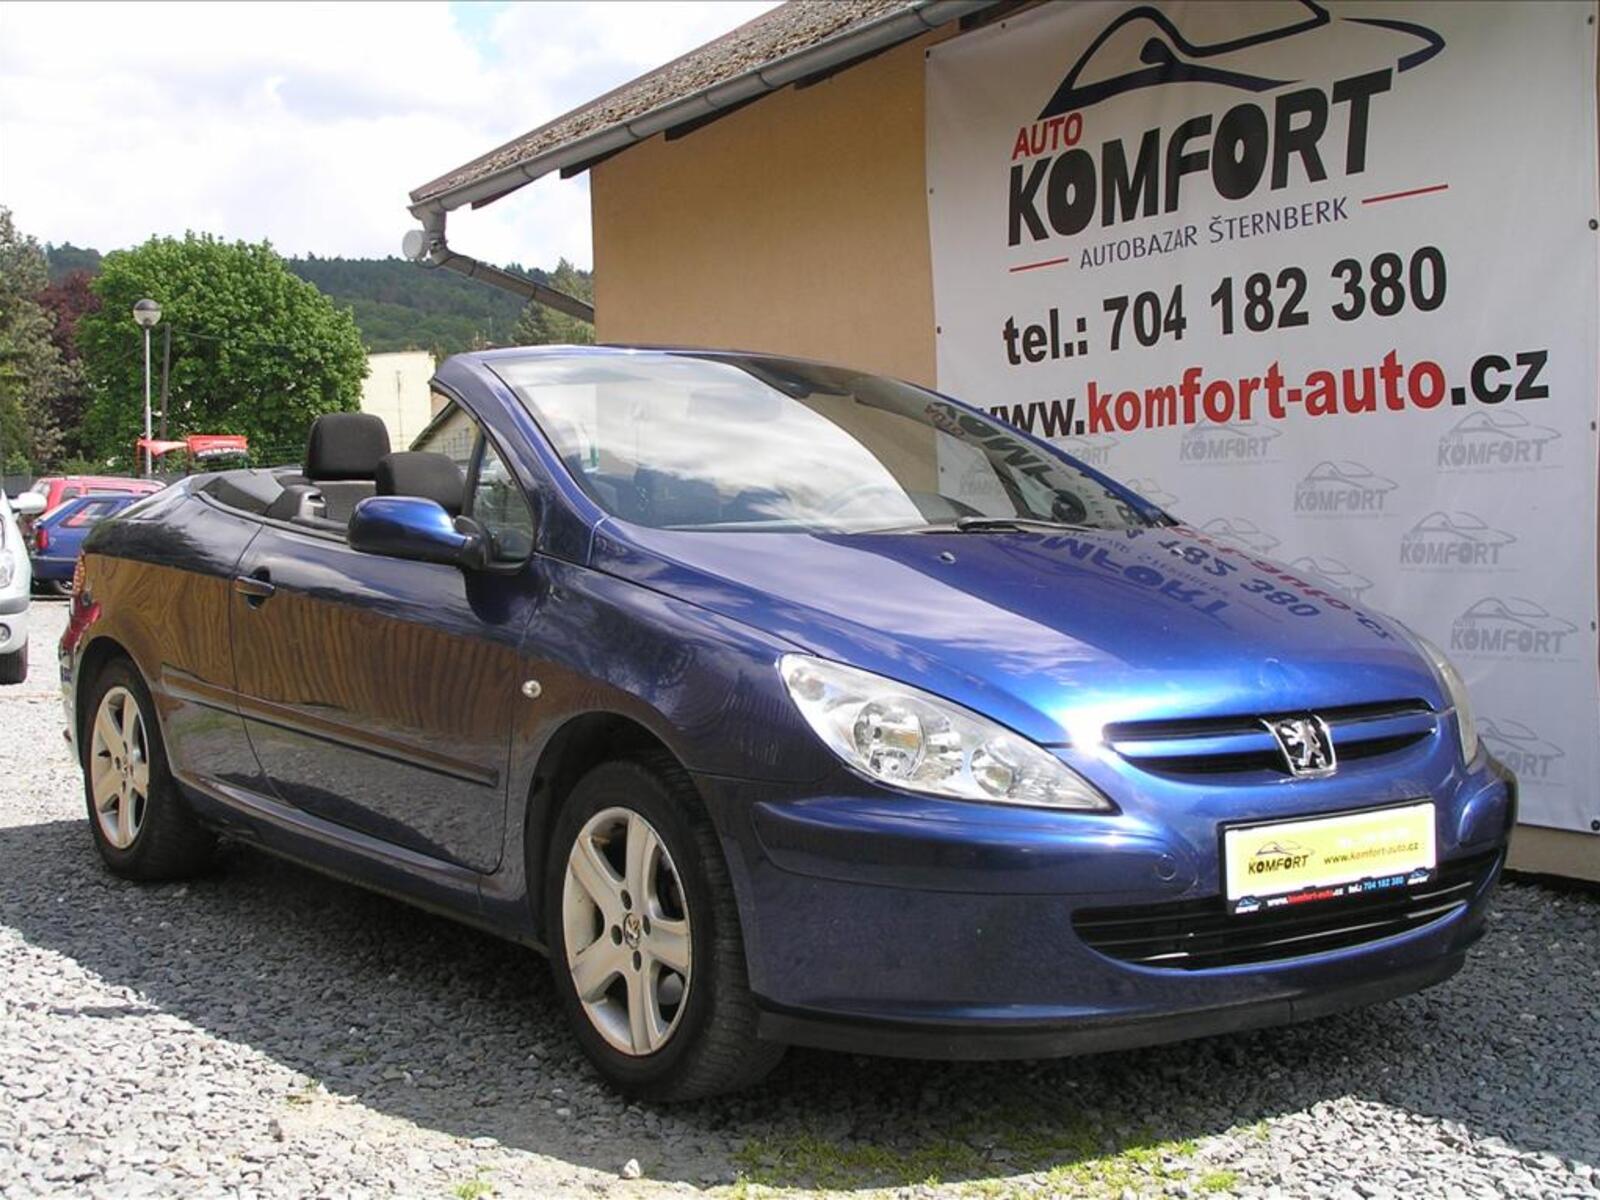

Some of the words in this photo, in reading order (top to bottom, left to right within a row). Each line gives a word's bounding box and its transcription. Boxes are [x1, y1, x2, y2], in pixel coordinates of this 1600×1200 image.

[1012, 112, 1082, 160] AUTO
[1008, 68, 1393, 247] KOMFORT
[1080, 225, 1197, 269] AUTOBAZAR
[1208, 196, 1348, 243] ŠTERNBERK
[1003, 308, 1088, 365] tel.:
[1103, 284, 1187, 351] 704
[1210, 266, 1309, 335] 182
[1331, 246, 1447, 321] 380
[977, 349, 1549, 438] ww.komfort-auto.cz
[1179, 436, 1272, 461] KOMFORT
[1437, 438, 1549, 467] KOMFORT
[1294, 488, 1388, 512] KOMFORT
[1400, 541, 1504, 564] KOMFORT
[1450, 628, 1568, 653] KOMFORT
[1248, 854, 1310, 875] KOMFORT
